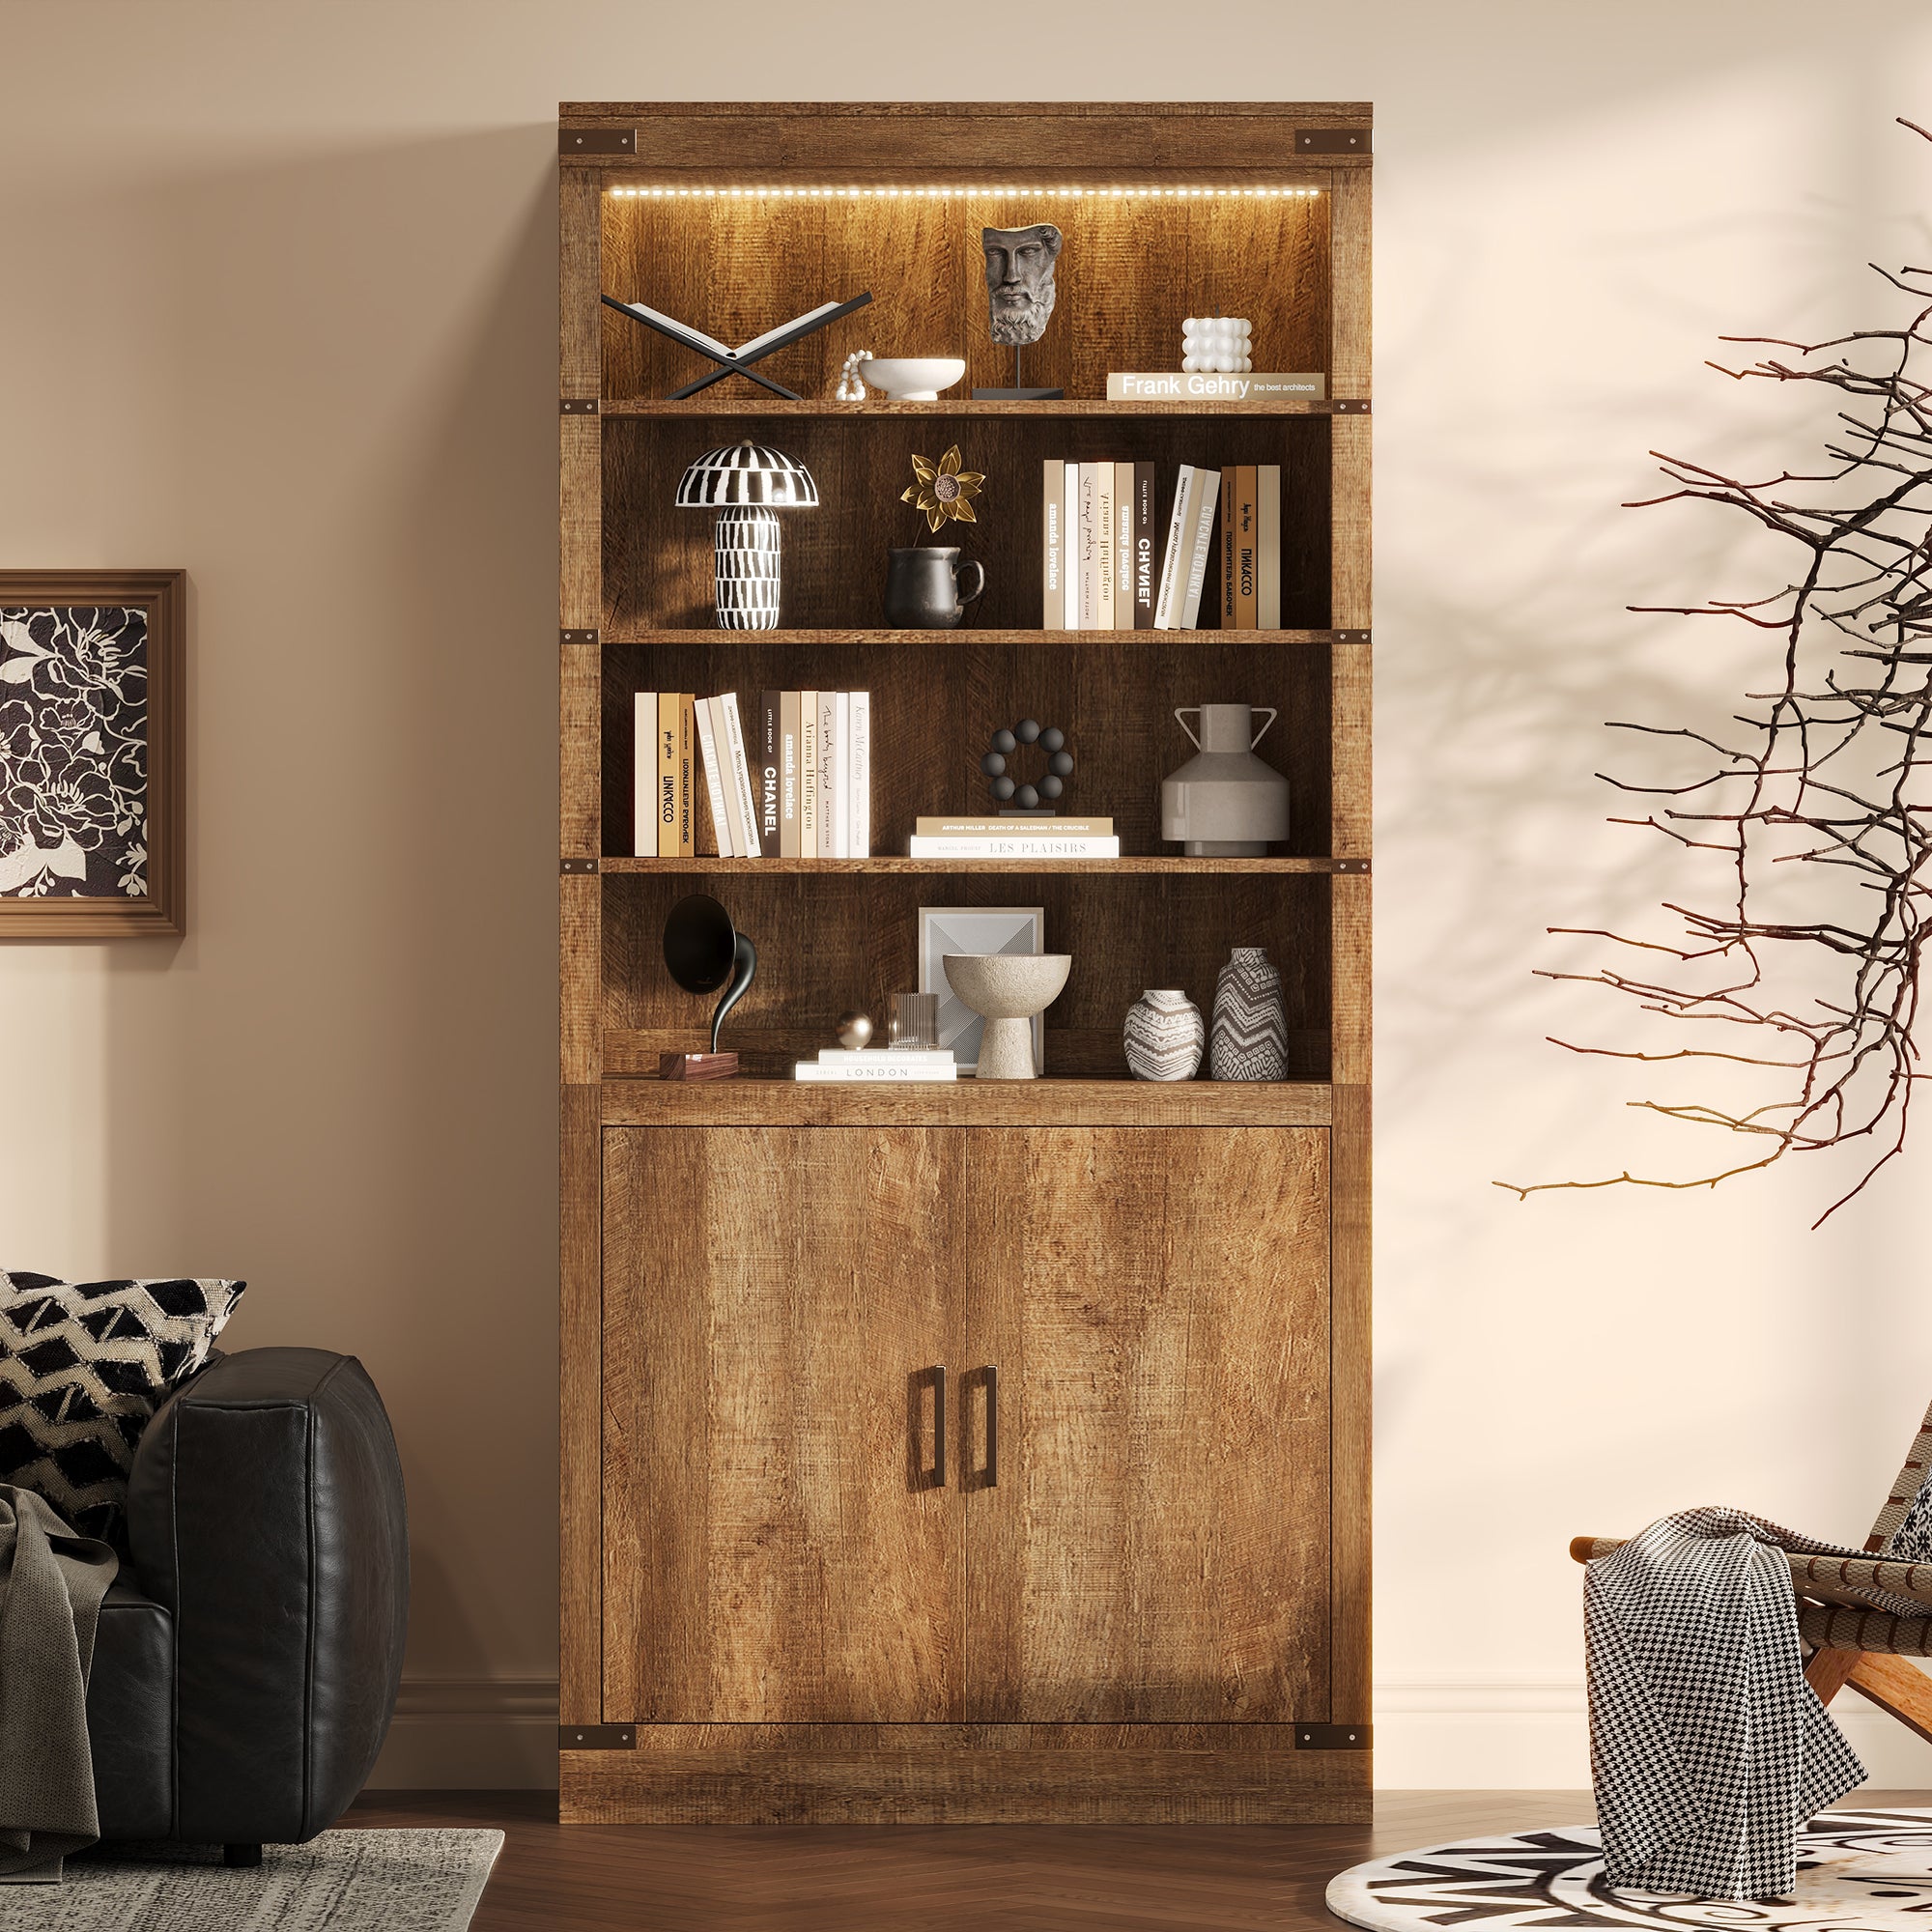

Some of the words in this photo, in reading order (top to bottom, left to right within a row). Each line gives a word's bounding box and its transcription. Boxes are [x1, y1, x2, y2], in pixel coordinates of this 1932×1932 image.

[1122, 375, 1181, 395] Frank
[1187, 375, 1251, 399] Gehry
[1253, 383, 1265, 391] the
[1266, 383, 1282, 391] best
[1282, 383, 1317, 391] architects
[1048, 503, 1059, 545] amanda
[1048, 547, 1059, 590] lovelace
[1240, 548, 1252, 596] ПИКАССО
[823, 705, 833, 726] The
[855, 705, 866, 731] Karen
[767, 745, 773, 753] OF
[784, 734, 795, 775] amanda
[806, 722, 815, 764] Arianna
[854, 734, 866, 781] McCartney
[701, 734, 719, 780] СПАСИТЕ
[711, 781, 727, 827] КОТИКА!
[818, 756, 833, 790] beyond
[764, 767, 777, 837] CHANEL
[784, 777, 795, 819] lovelace
[803, 769, 815, 830] Huffington
[989, 842, 1015, 854] LES
[1021, 842, 1087, 854] PLAISIRS
[846, 1068, 909, 1077] LONDON
